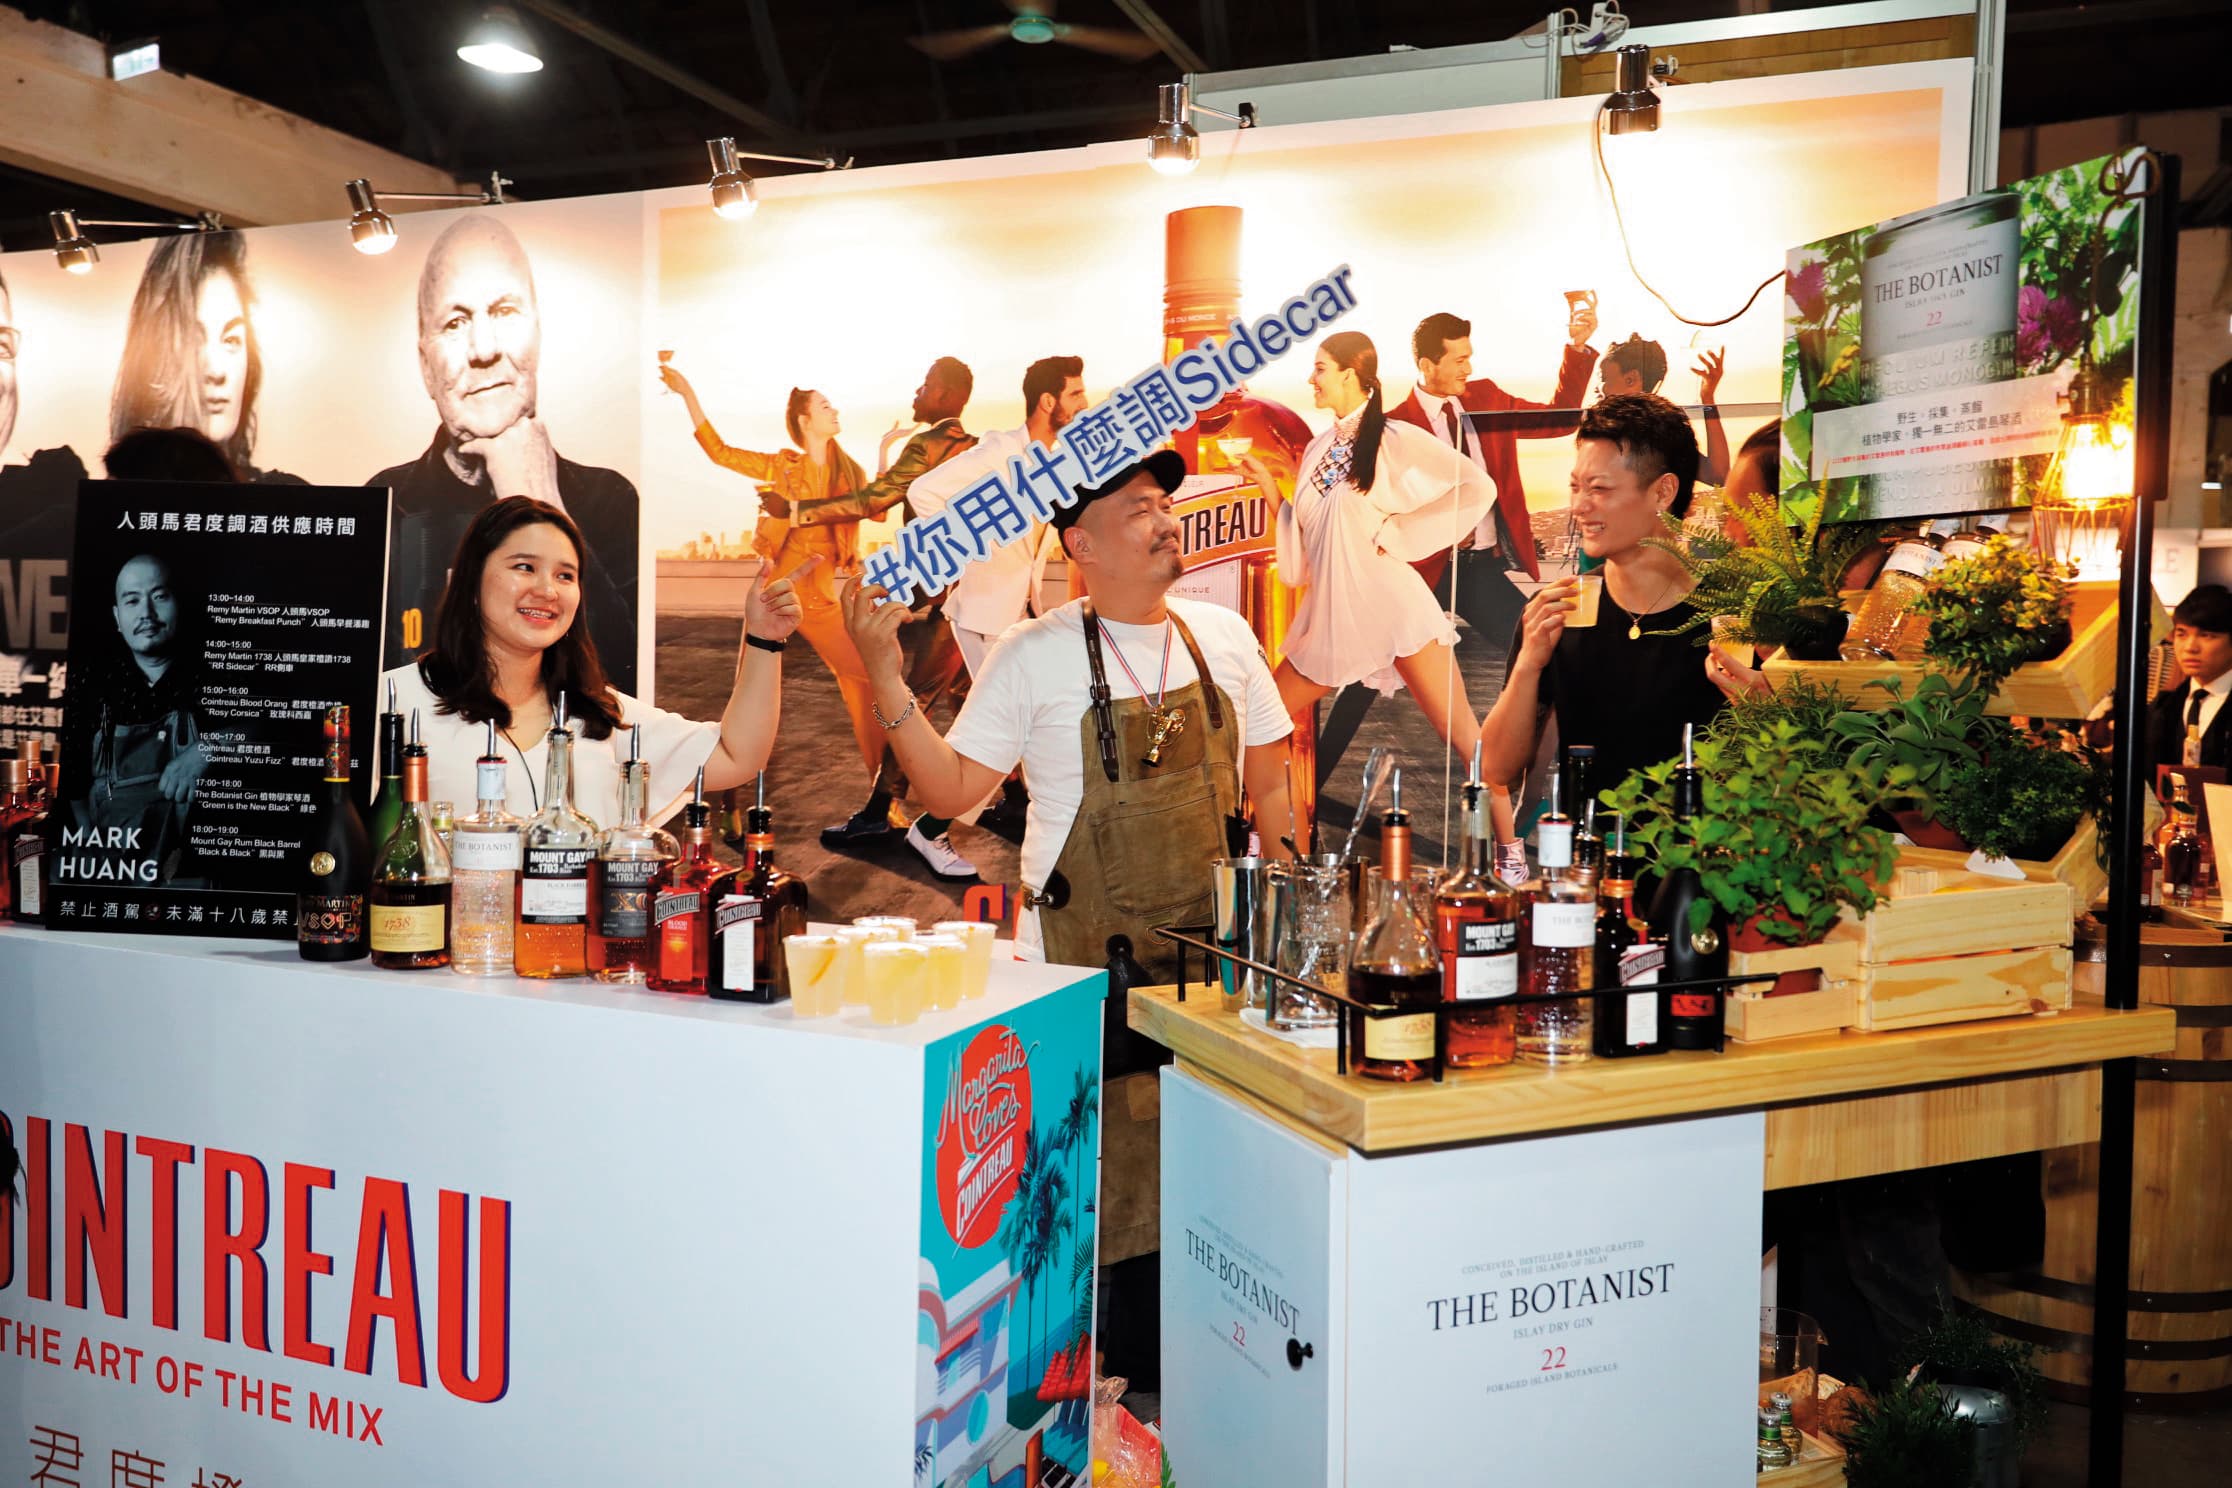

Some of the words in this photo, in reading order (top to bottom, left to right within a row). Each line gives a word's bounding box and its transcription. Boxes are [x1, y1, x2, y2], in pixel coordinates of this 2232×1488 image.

[1874, 279, 1904, 303] THE
[1908, 254, 2003, 296] BOTANIST
[1926, 311, 1943, 327] 22
[868, 265, 1358, 605] #你用什麼調Sidecar
[117, 511, 356, 536] 人頭馬君度調酒供應時間
[1180, 497, 1266, 556] TREAU
[207, 605, 230, 615] Remy
[231, 606, 256, 615] Martin
[257, 607, 281, 615] VSOP
[239, 616, 275, 626] Breakfast
[204, 651, 226, 661] Remy
[228, 652, 253, 661] Martin
[254, 653, 272, 661] 1738
[201, 697, 239, 707] Cointreau
[240, 699, 262, 708] Blood
[264, 700, 288, 709] Orang
[198, 744, 235, 753] Cointreau
[244, 756, 264, 764] Yuzu
[195, 790, 209, 799] The
[211, 791, 243, 800] Botanist
[244, 792, 258, 800] Gin
[227, 802, 234, 810] is
[235, 802, 249, 811] the
[250, 803, 267, 811] New
[62, 825, 143, 850] MARK
[190, 836, 216, 845] Mount
[217, 838, 233, 847] Gay
[234, 838, 252, 846] Rum
[254, 839, 276, 848] Black
[277, 840, 301, 849] Barrel
[529, 851, 566, 863] MOUNT
[566, 852, 588, 863] GAY
[58, 856, 159, 882] HUANG
[538, 863, 559, 874] 1703
[608, 862, 640, 873] MOUNT
[641, 862, 659, 875] GAY
[616, 873, 634, 883] 1703
[60, 900, 141, 920] 禁止酒駕
[166, 904, 299, 926] 未滿十八歲禁
[1465, 925, 1500, 939] MOUNT
[1475, 938, 1496, 951] 1703
[935, 1017, 1040, 1159] Margarita
[969, 1082, 1022, 1149] Loves
[956, 1135, 1014, 1239] COINTREAU
[1499, 1270, 1514, 1279] ON
[1516, 1267, 1533, 1277] THE
[1535, 1261, 1569, 1275] ISLAND
[1570, 1260, 1582, 1269] OF
[1185, 1228, 1215, 1273] THE
[1219, 1252, 1300, 1336] BOTANIST
[1427, 1291, 1498, 1331] THE
[1509, 1263, 1675, 1319] BOTANIST
[1232, 1321, 1246, 1347] 22
[1513, 1324, 1545, 1340] ISLAY
[1548, 1319, 1570, 1334] DRY
[1573, 1316, 1594, 1329] GIN
[1540, 1346, 1567, 1371] 22
[0, 1317, 61, 1366] THE
[73, 1337, 144, 1386] ART
[156, 1355, 203, 1398] OF
[215, 1370, 292, 1424] THE
[309, 1391, 384, 1446] MIX
[1530, 1372, 1563, 1387] ISLAND
